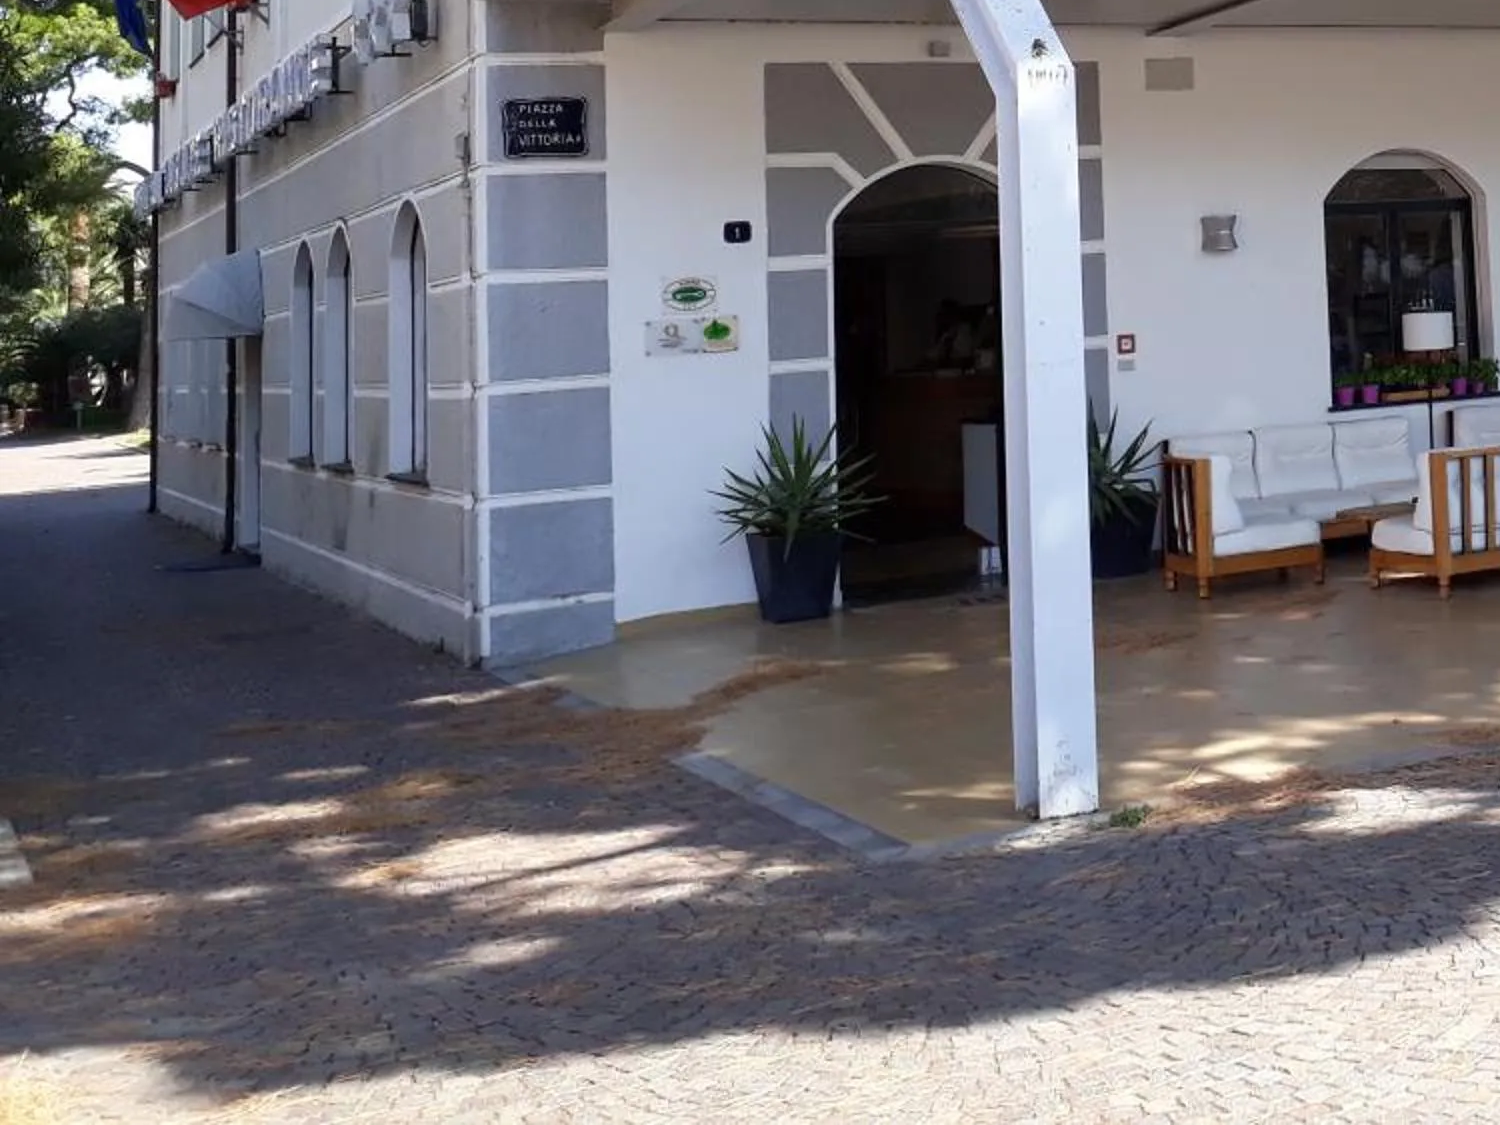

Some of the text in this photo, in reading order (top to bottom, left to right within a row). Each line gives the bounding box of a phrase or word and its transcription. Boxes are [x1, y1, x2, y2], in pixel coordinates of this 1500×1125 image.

[519, 104, 563, 114] PIAZZA
[518, 118, 557, 128] DELLA
[518, 132, 575, 147] VITTORIA
